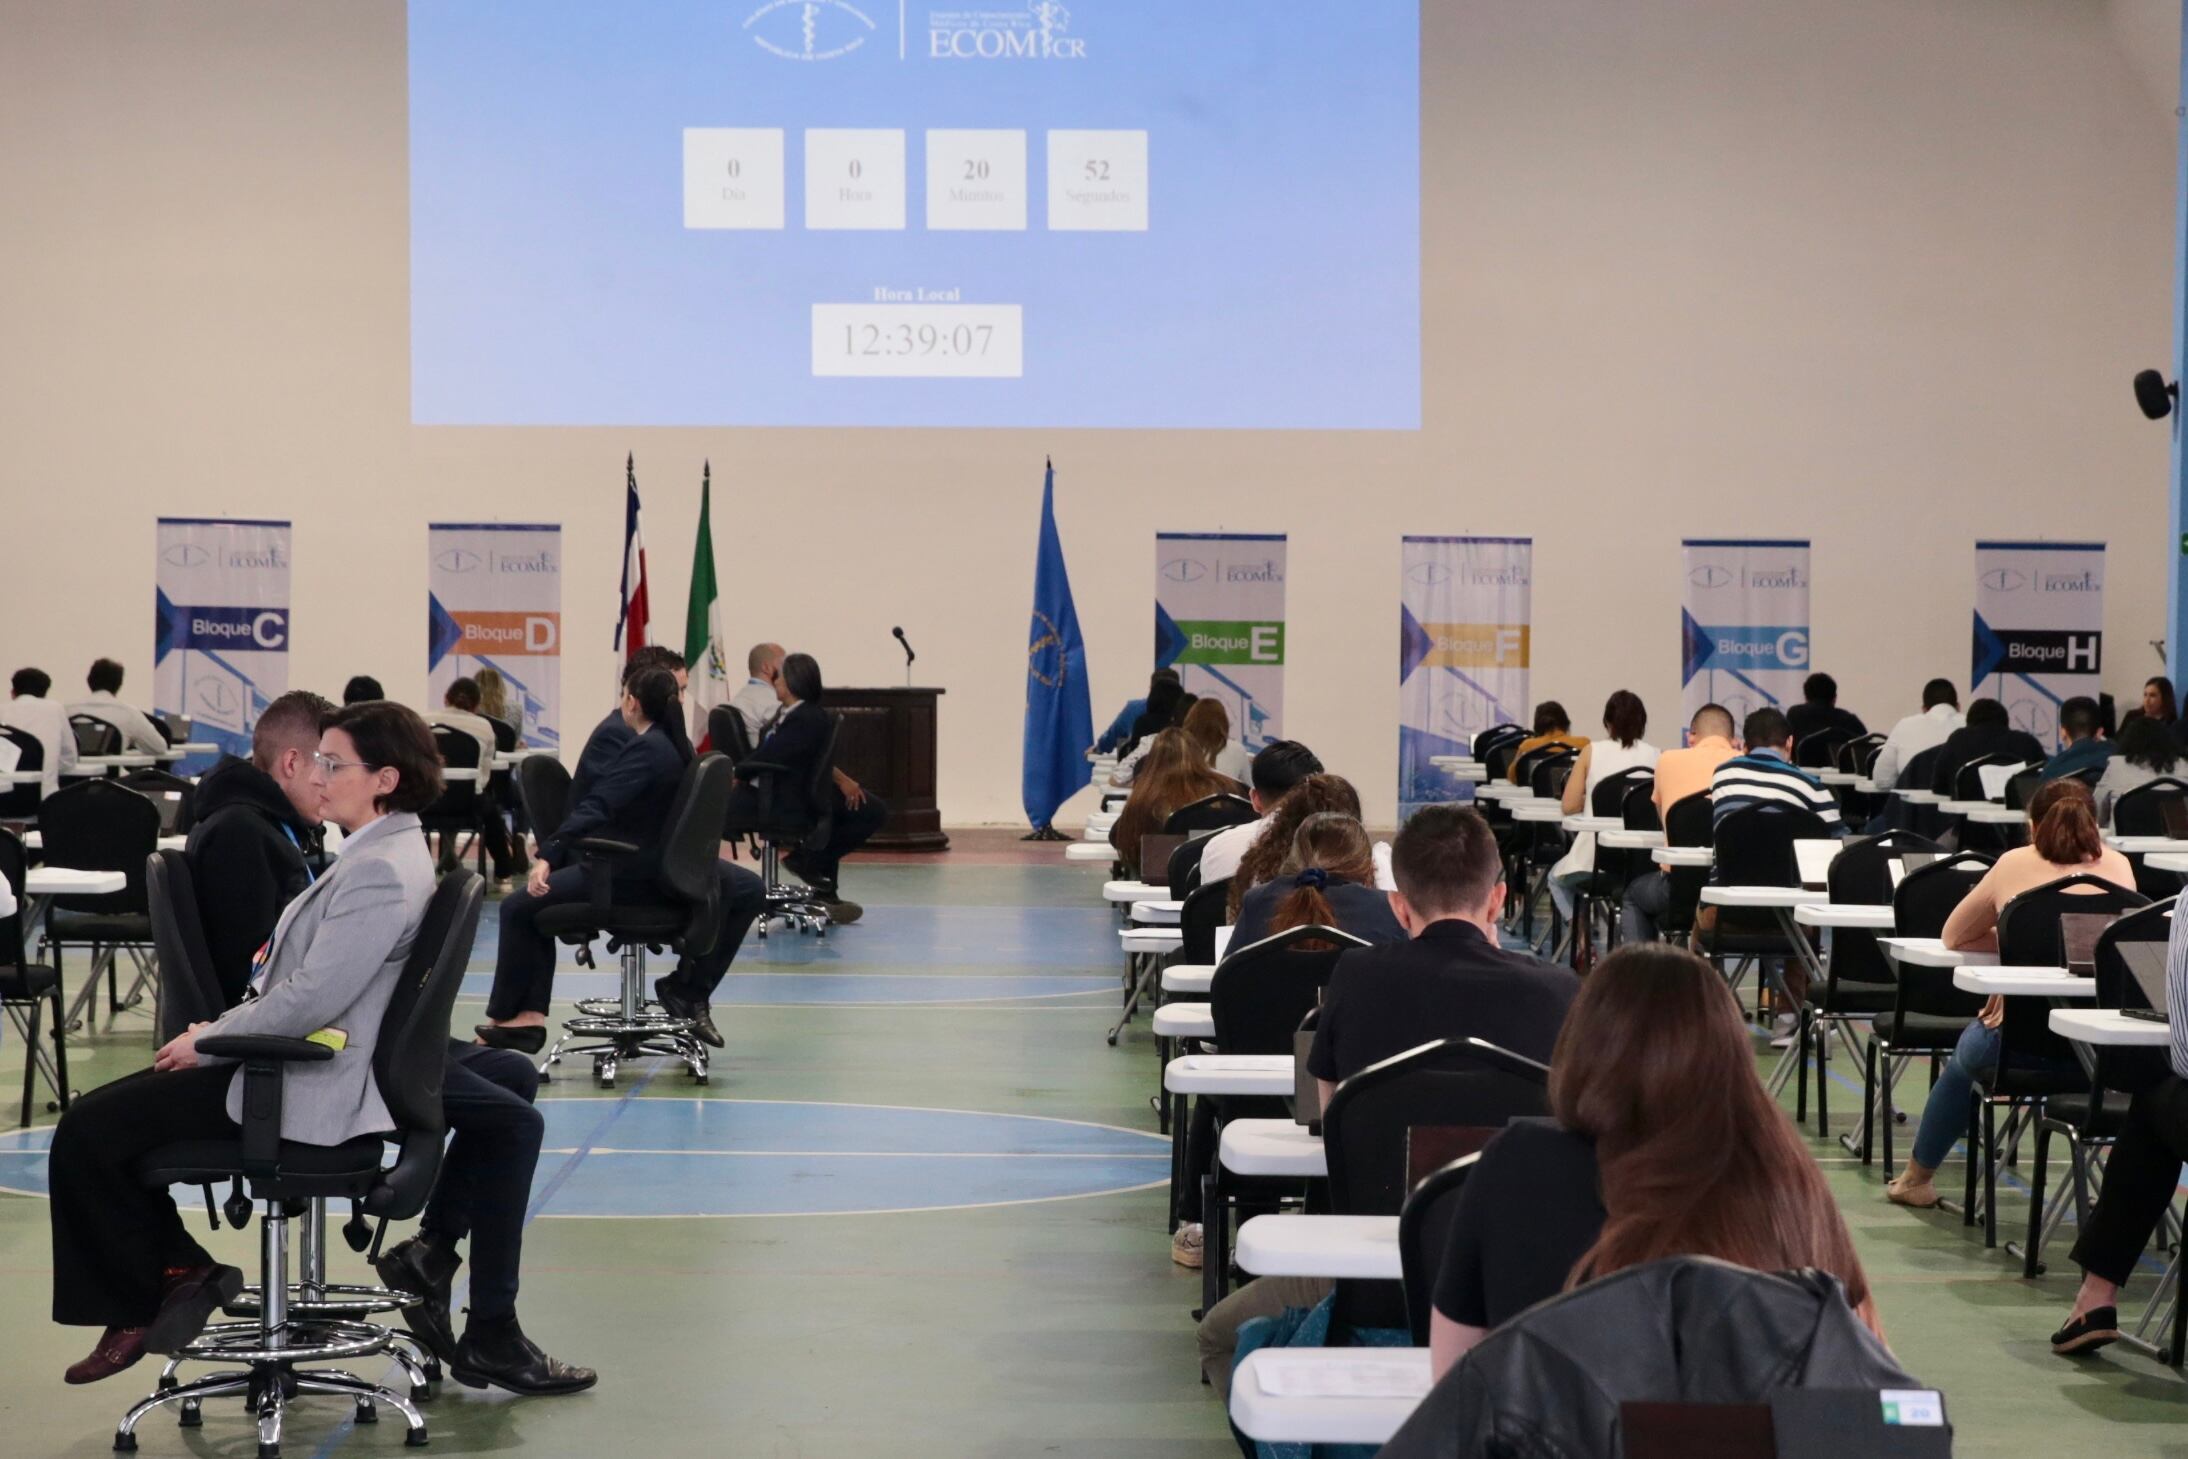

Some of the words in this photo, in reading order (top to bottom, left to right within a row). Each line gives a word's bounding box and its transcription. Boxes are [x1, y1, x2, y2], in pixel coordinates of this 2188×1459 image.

[727, 158, 741, 178] 0
[849, 158, 862, 179] 0
[963, 159, 990, 180] 20
[1084, 160, 1111, 181] 52
[874, 286, 913, 301] Hora
[918, 287, 960, 301] Local
[845, 322, 993, 356] 12:39:07
[192, 618, 252, 639] Bloque
[252, 612, 285, 648] C
[465, 623, 524, 644] Bloque
[525, 616, 556, 652] D
[1191, 632, 1249, 652] Bloque
[1251, 626, 1278, 661] E
[1437, 635, 1494, 655] Bloque
[1496, 630, 1521, 662] F
[1718, 638, 1775, 658] Bloque
[1776, 631, 1809, 666] G
[2008, 642, 2065, 661] Bloque
[2067, 635, 2097, 670] H
